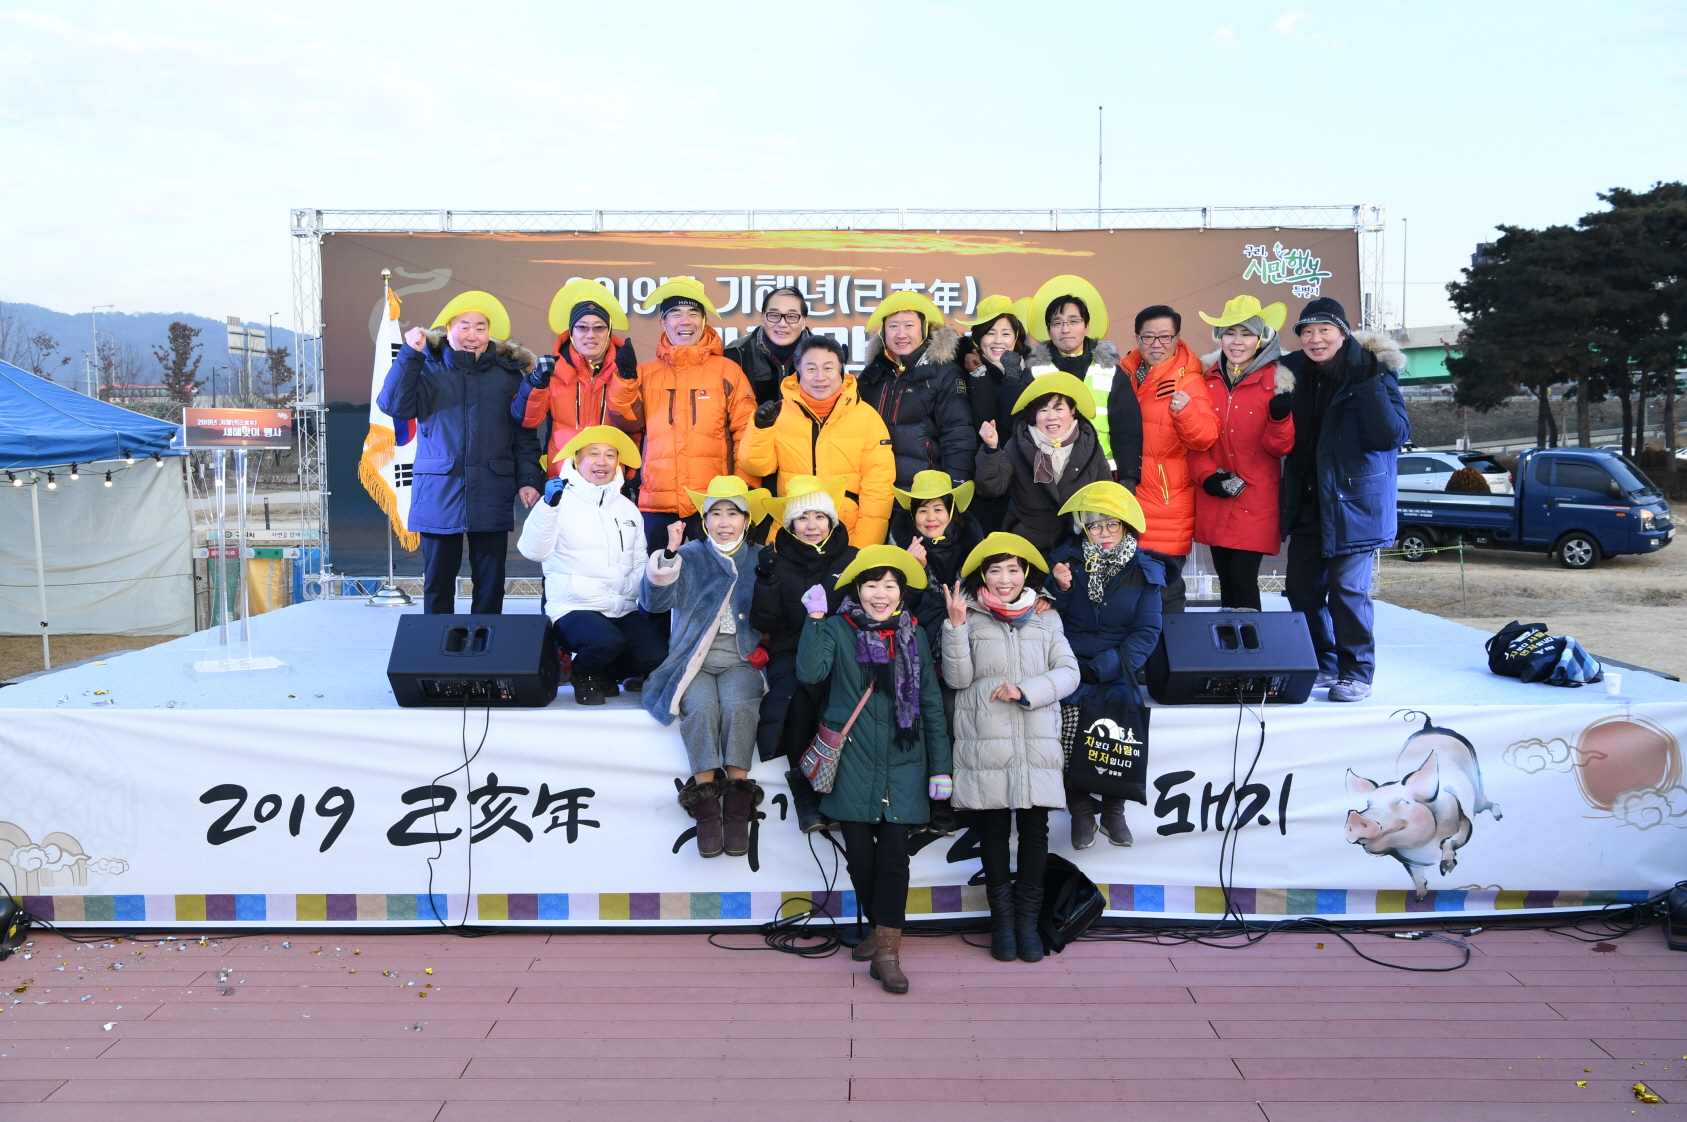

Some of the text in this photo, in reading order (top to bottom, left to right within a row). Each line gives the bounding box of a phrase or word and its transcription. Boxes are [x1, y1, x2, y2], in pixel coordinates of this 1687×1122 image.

[1243, 247, 1333, 286] 시민행복
[1292, 284, 1320, 298] 특별시
[197, 418, 218, 426] 2019년
[223, 425, 282, 438] 새해맞이 행사
[1084, 736, 1140, 757] 차보다 사람이
[1087, 749, 1132, 768] 먼저입니다
[199, 783, 355, 853] 2019
